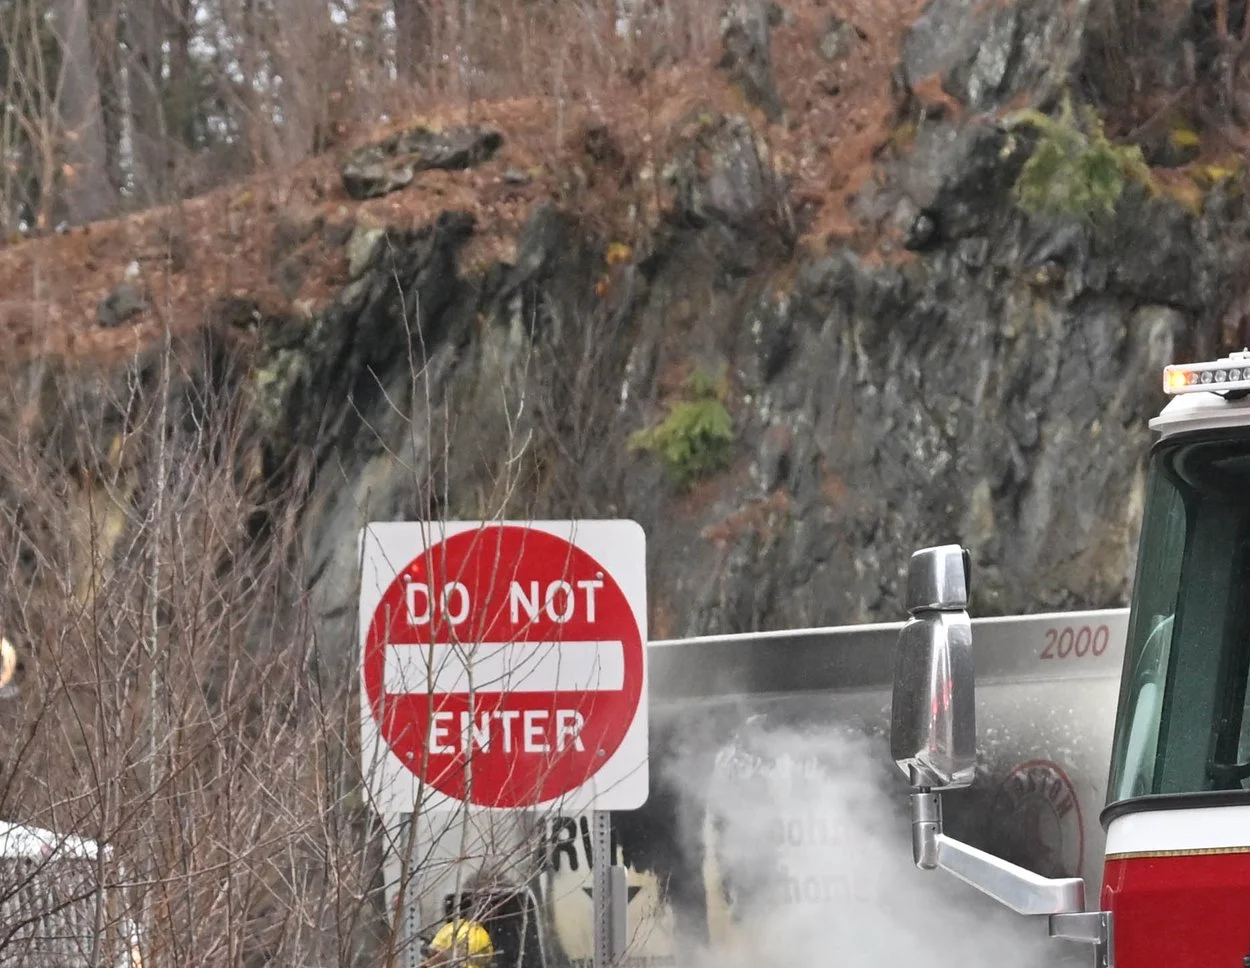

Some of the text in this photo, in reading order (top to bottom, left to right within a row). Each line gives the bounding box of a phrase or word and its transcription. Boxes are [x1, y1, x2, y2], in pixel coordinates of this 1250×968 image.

[405, 580, 604, 625] DO NOT
[1040, 624, 1110, 659] 2000
[428, 709, 586, 755] ENTER
